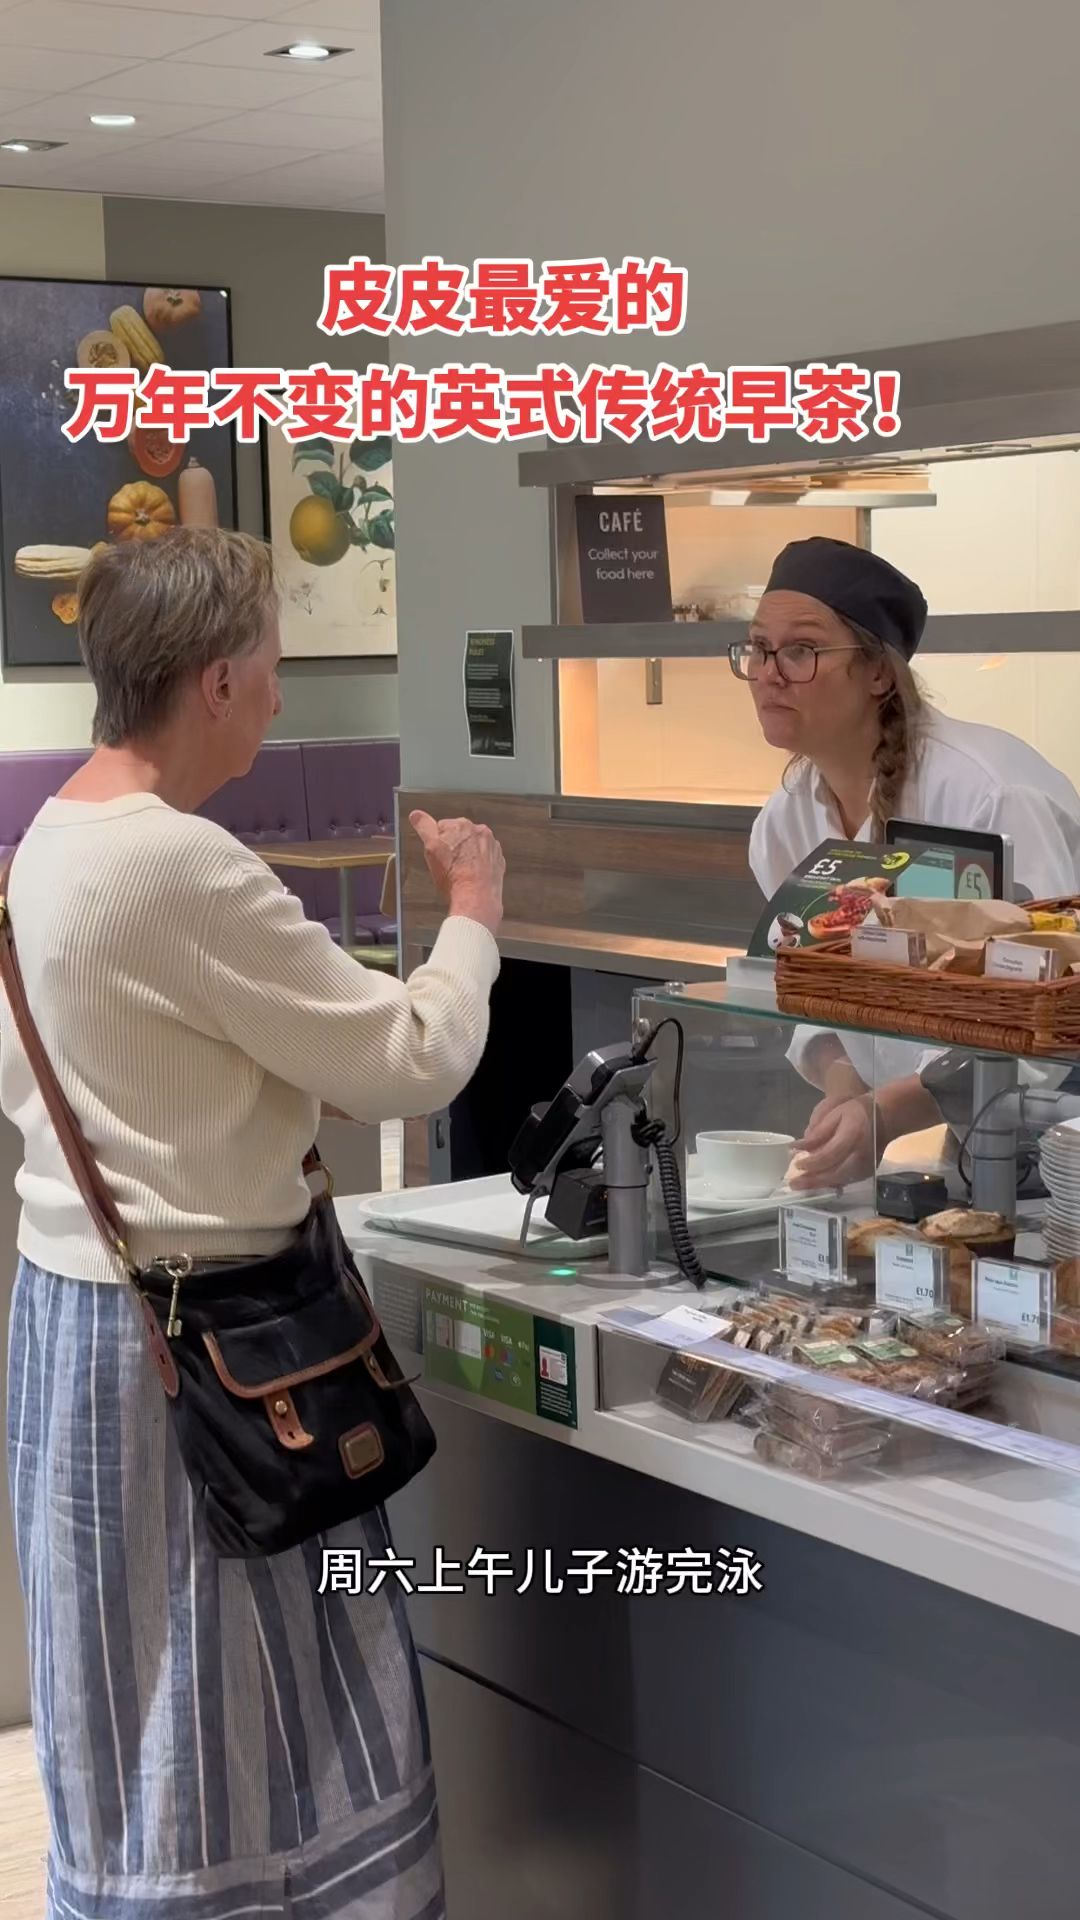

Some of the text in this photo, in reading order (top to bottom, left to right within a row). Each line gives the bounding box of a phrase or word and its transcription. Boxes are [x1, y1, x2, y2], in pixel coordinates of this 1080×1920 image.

[598, 508, 644, 533] CAFÉ
[588, 548, 658, 563] Collect your
[596, 567, 655, 580] food here
[808, 857, 843, 876] £5
[425, 1287, 468, 1313] PAYMENT
[916, 1286, 934, 1299] £1.70
[500, 1335, 513, 1345] VISA
